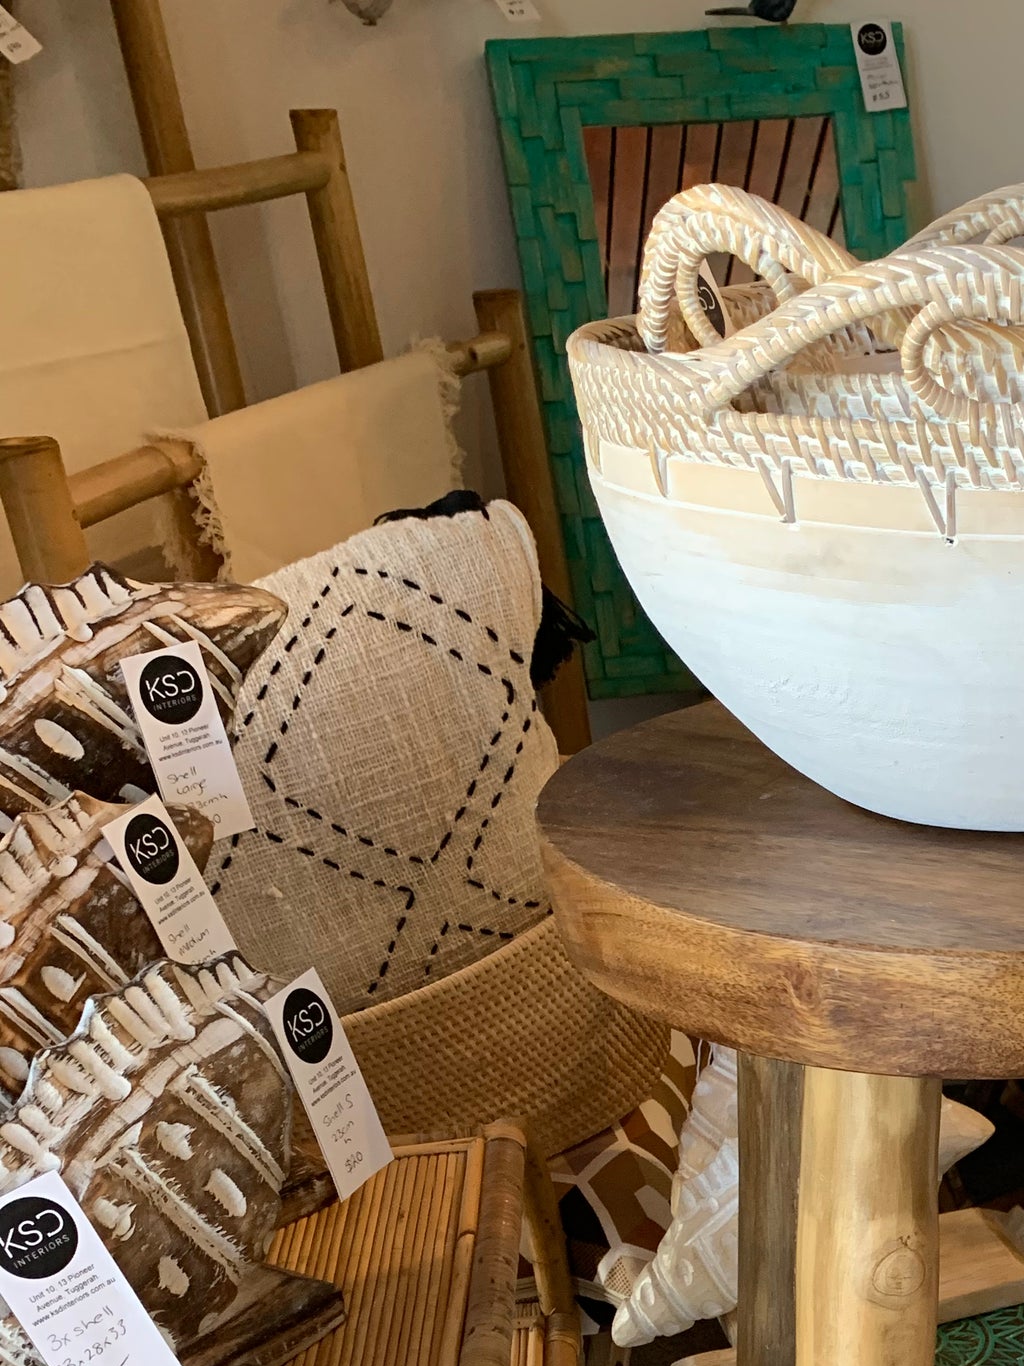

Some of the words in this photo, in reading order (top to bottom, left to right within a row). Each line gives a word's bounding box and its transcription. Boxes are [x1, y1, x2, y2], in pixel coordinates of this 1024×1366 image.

[145, 670, 195, 702] KSD
[153, 694, 196, 711] INTERIORS
[130, 827, 169, 865] KSD
[287, 1001, 324, 1042] KSD
[0, 1209, 64, 1258] KSD
[13, 1234, 70, 1269] INTERIORS
[28, 1291, 44, 1304] Unit
[58, 1278, 67, 1290] 13
[67, 1263, 95, 1286] Pioneer
[65, 1275, 99, 1297] Tuggerah
